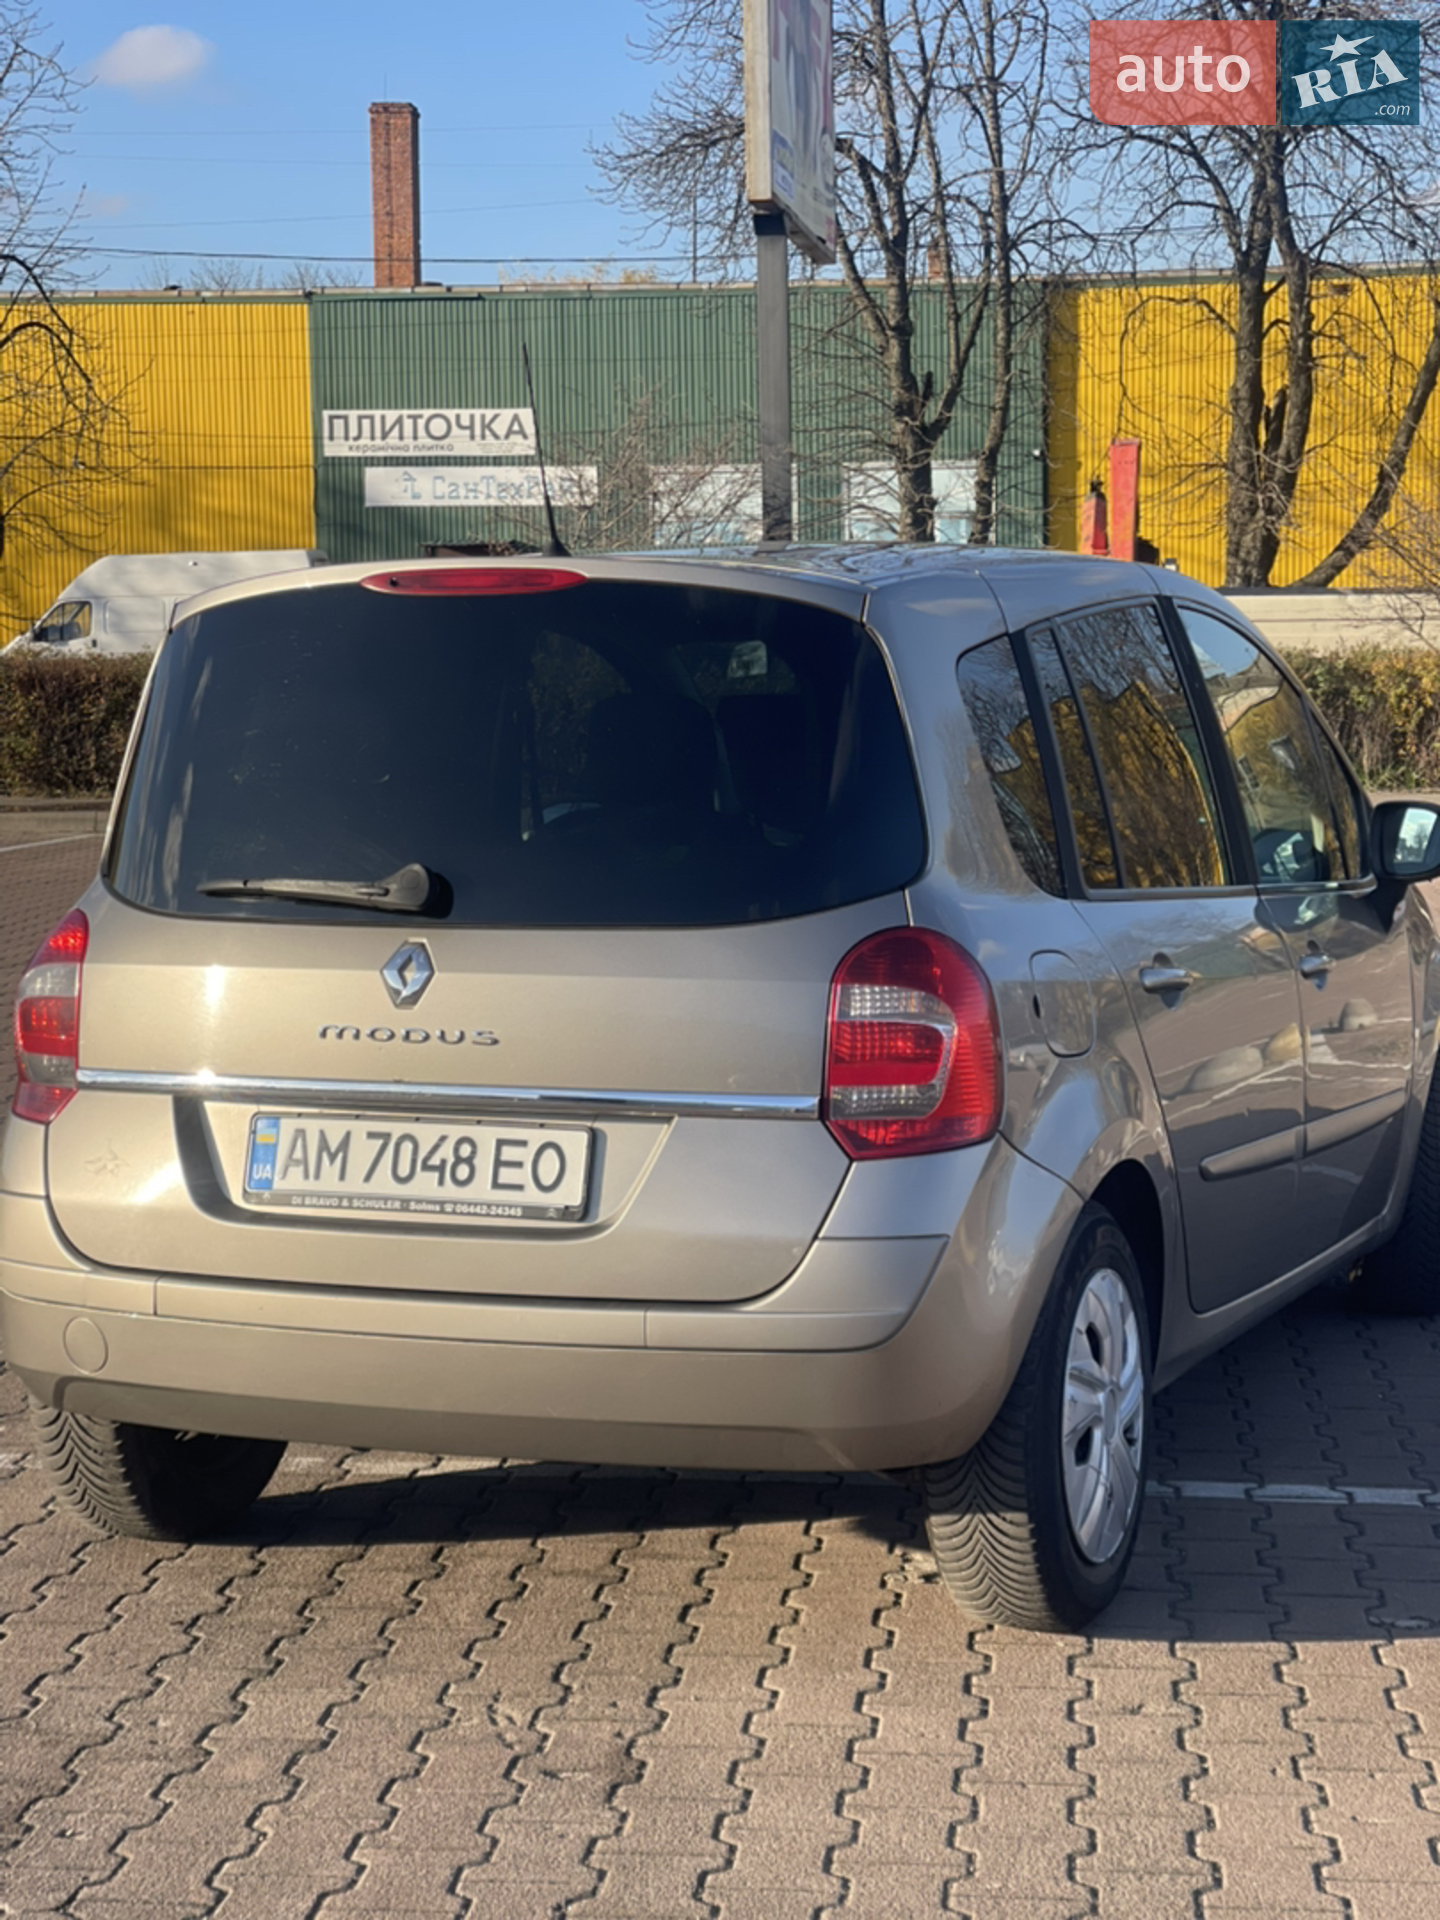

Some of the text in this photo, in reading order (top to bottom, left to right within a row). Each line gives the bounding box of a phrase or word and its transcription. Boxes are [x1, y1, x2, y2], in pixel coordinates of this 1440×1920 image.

[327, 413, 529, 442] ПЛИТОЧКА
[412, 443, 454, 453] плитка
[318, 1024, 500, 1046] MODUS
[281, 1128, 567, 1194] AM 7048 EO
[252, 1164, 272, 1181] UA
[304, 1196, 339, 1207] BRAVO
